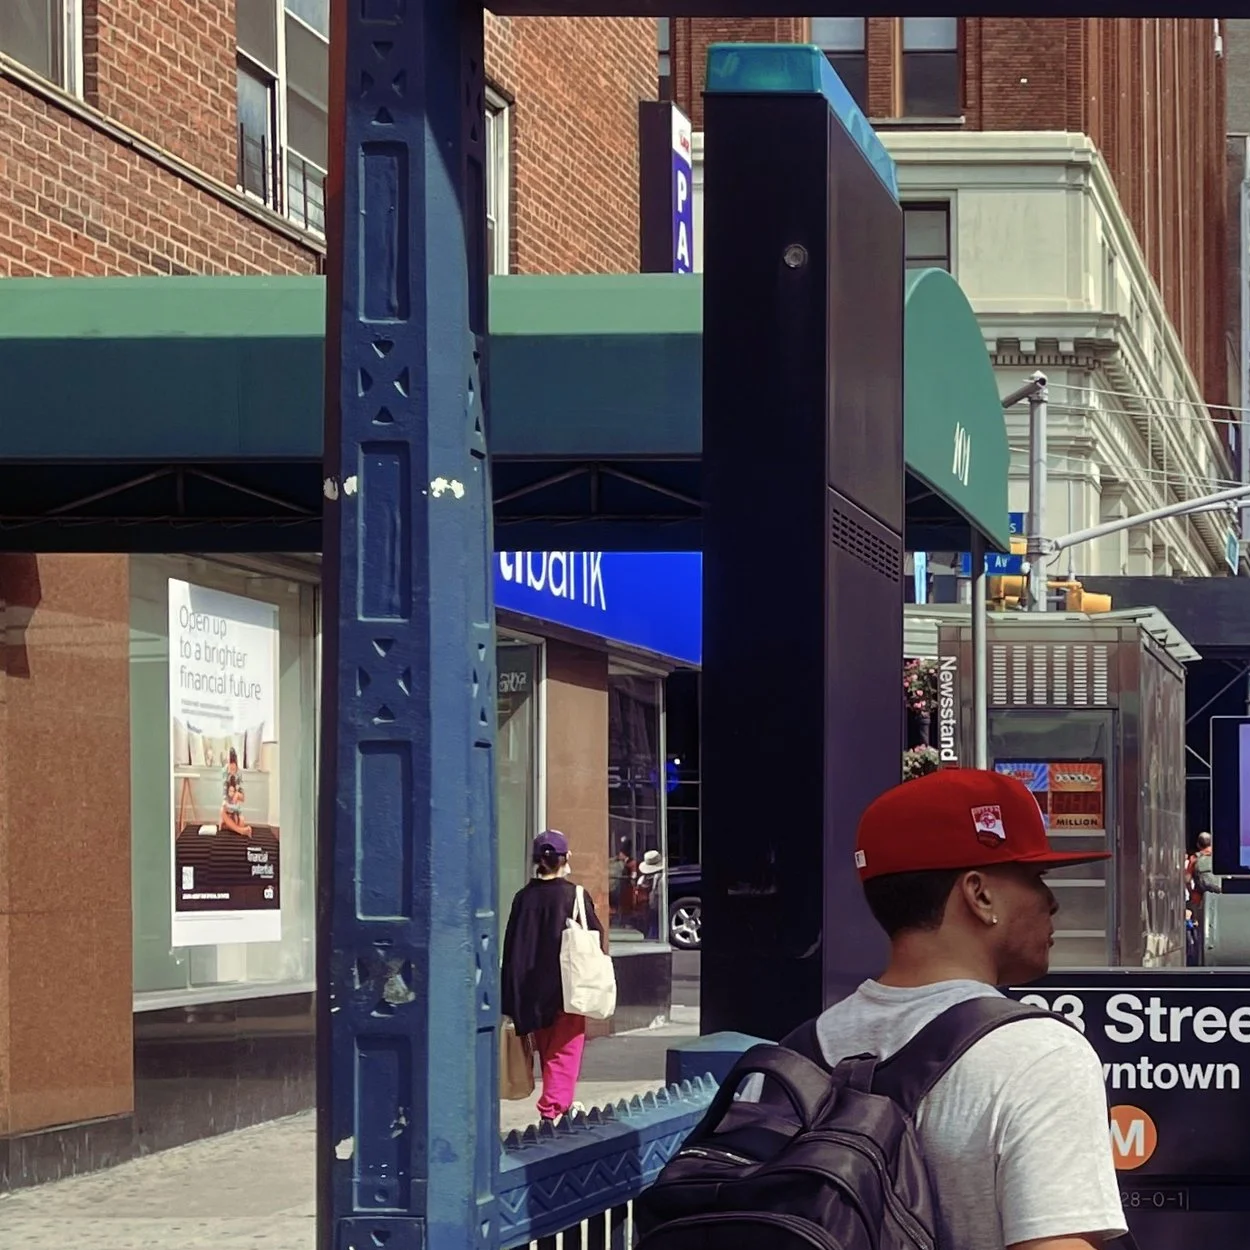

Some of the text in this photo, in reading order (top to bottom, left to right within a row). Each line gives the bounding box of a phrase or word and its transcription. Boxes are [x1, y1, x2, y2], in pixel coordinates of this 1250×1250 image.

[676, 169, 690, 273] PA
[952, 421, 970, 486] 101
[995, 556, 1008, 568] Av
[179, 605, 228, 641] Open up
[180, 635, 248, 670] to a brighter
[179, 664, 262, 701] financial future
[939, 655, 959, 762] Newsstand
[1056, 818, 1098, 826] MILLION
[1111, 1119, 1145, 1157] M
